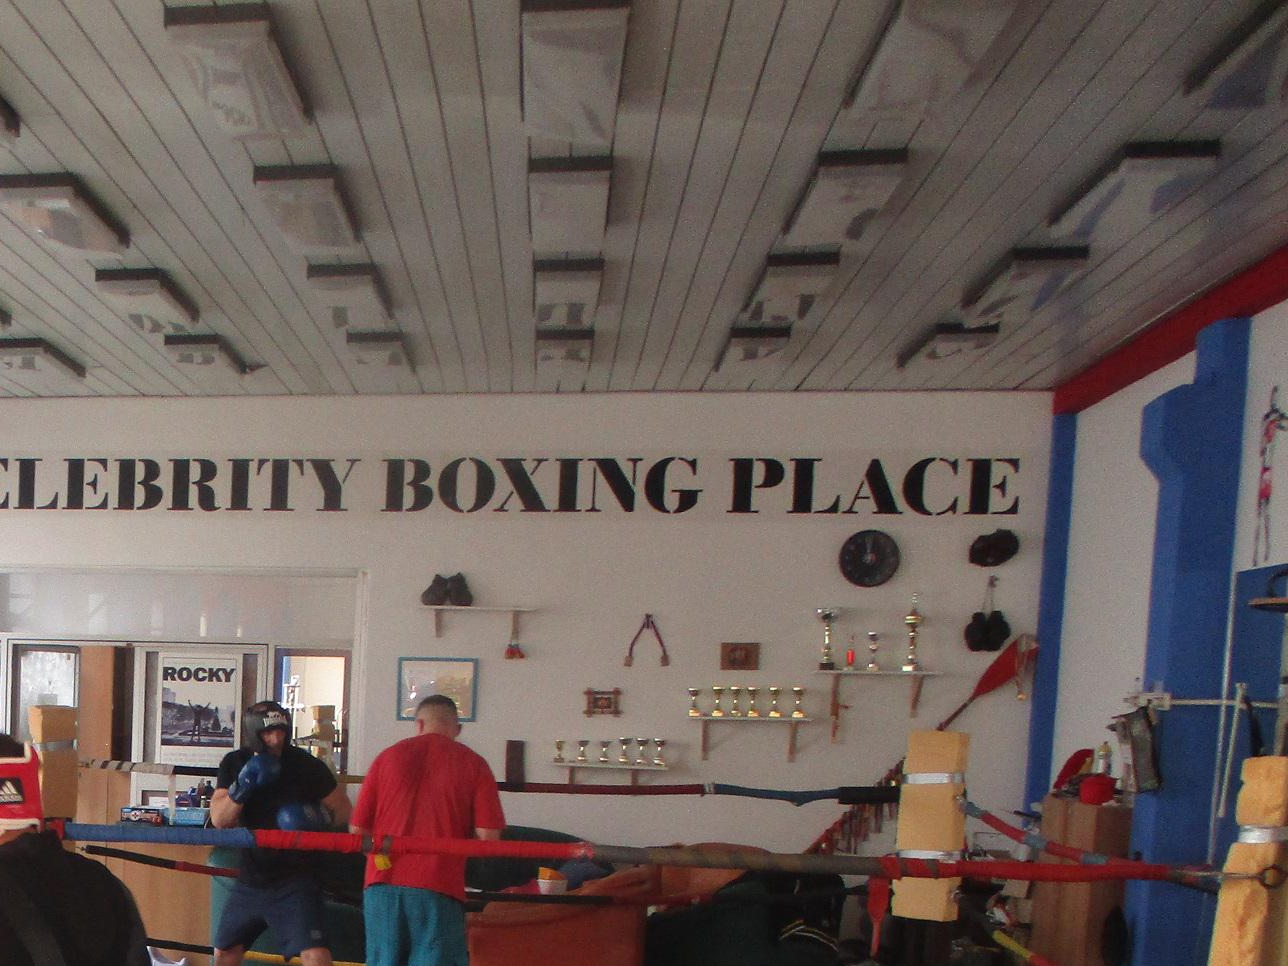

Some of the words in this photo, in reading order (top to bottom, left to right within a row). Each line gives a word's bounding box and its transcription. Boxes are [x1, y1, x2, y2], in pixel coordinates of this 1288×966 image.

[381, 456, 703, 514] BOXING
[726, 456, 1020, 516] PLACE
[163, 667, 236, 682] ROCKY
